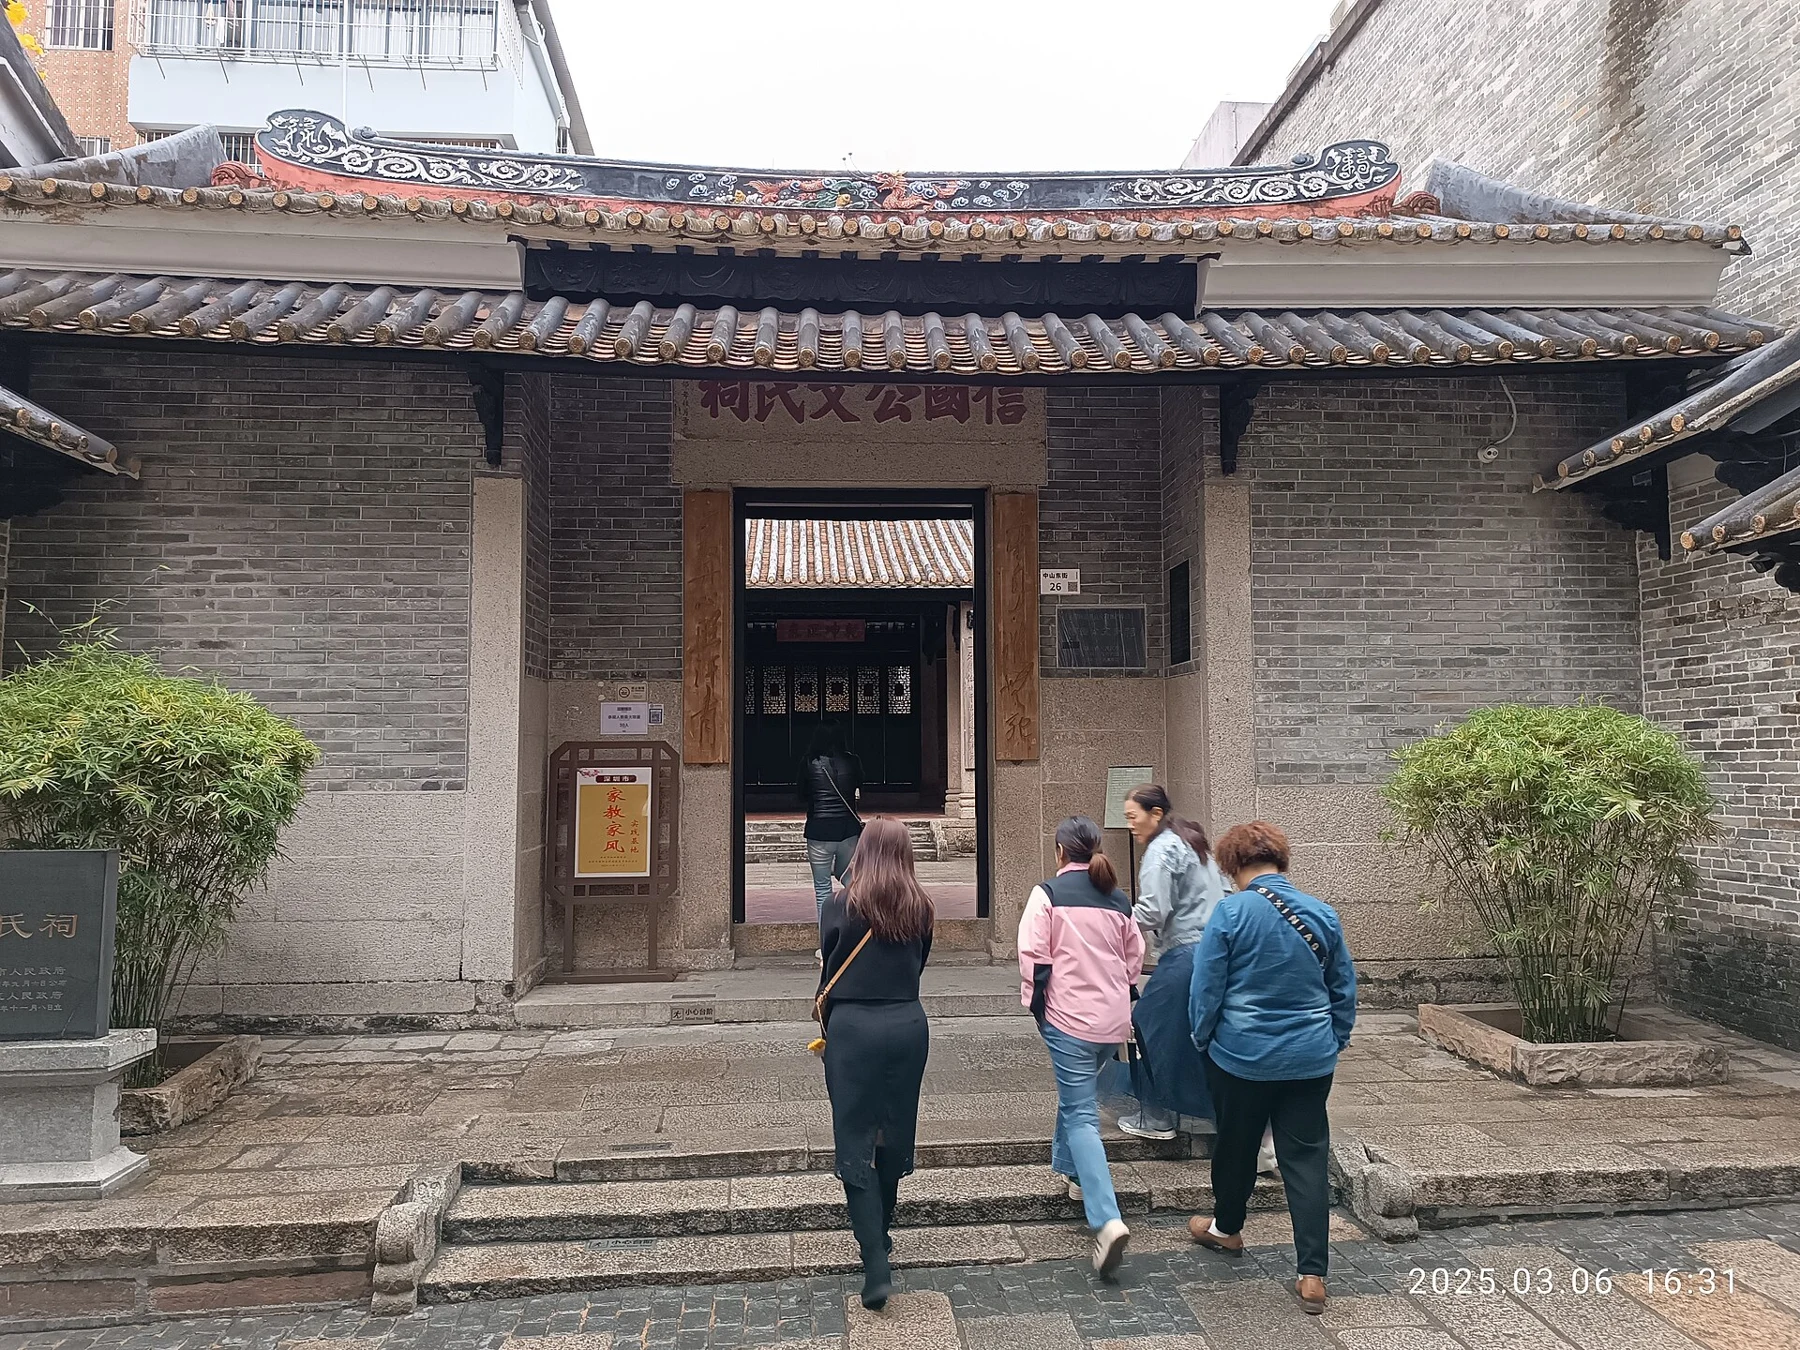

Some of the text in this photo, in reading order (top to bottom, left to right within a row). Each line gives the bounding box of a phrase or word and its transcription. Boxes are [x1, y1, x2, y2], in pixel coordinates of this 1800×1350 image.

[1042, 572, 1068, 580] 中山东街
[1049, 582, 1062, 591] 26
[602, 786, 627, 853] 家教家风
[0, 913, 79, 939] 氏祠
[685, 1007, 714, 1016] 小心台阶
